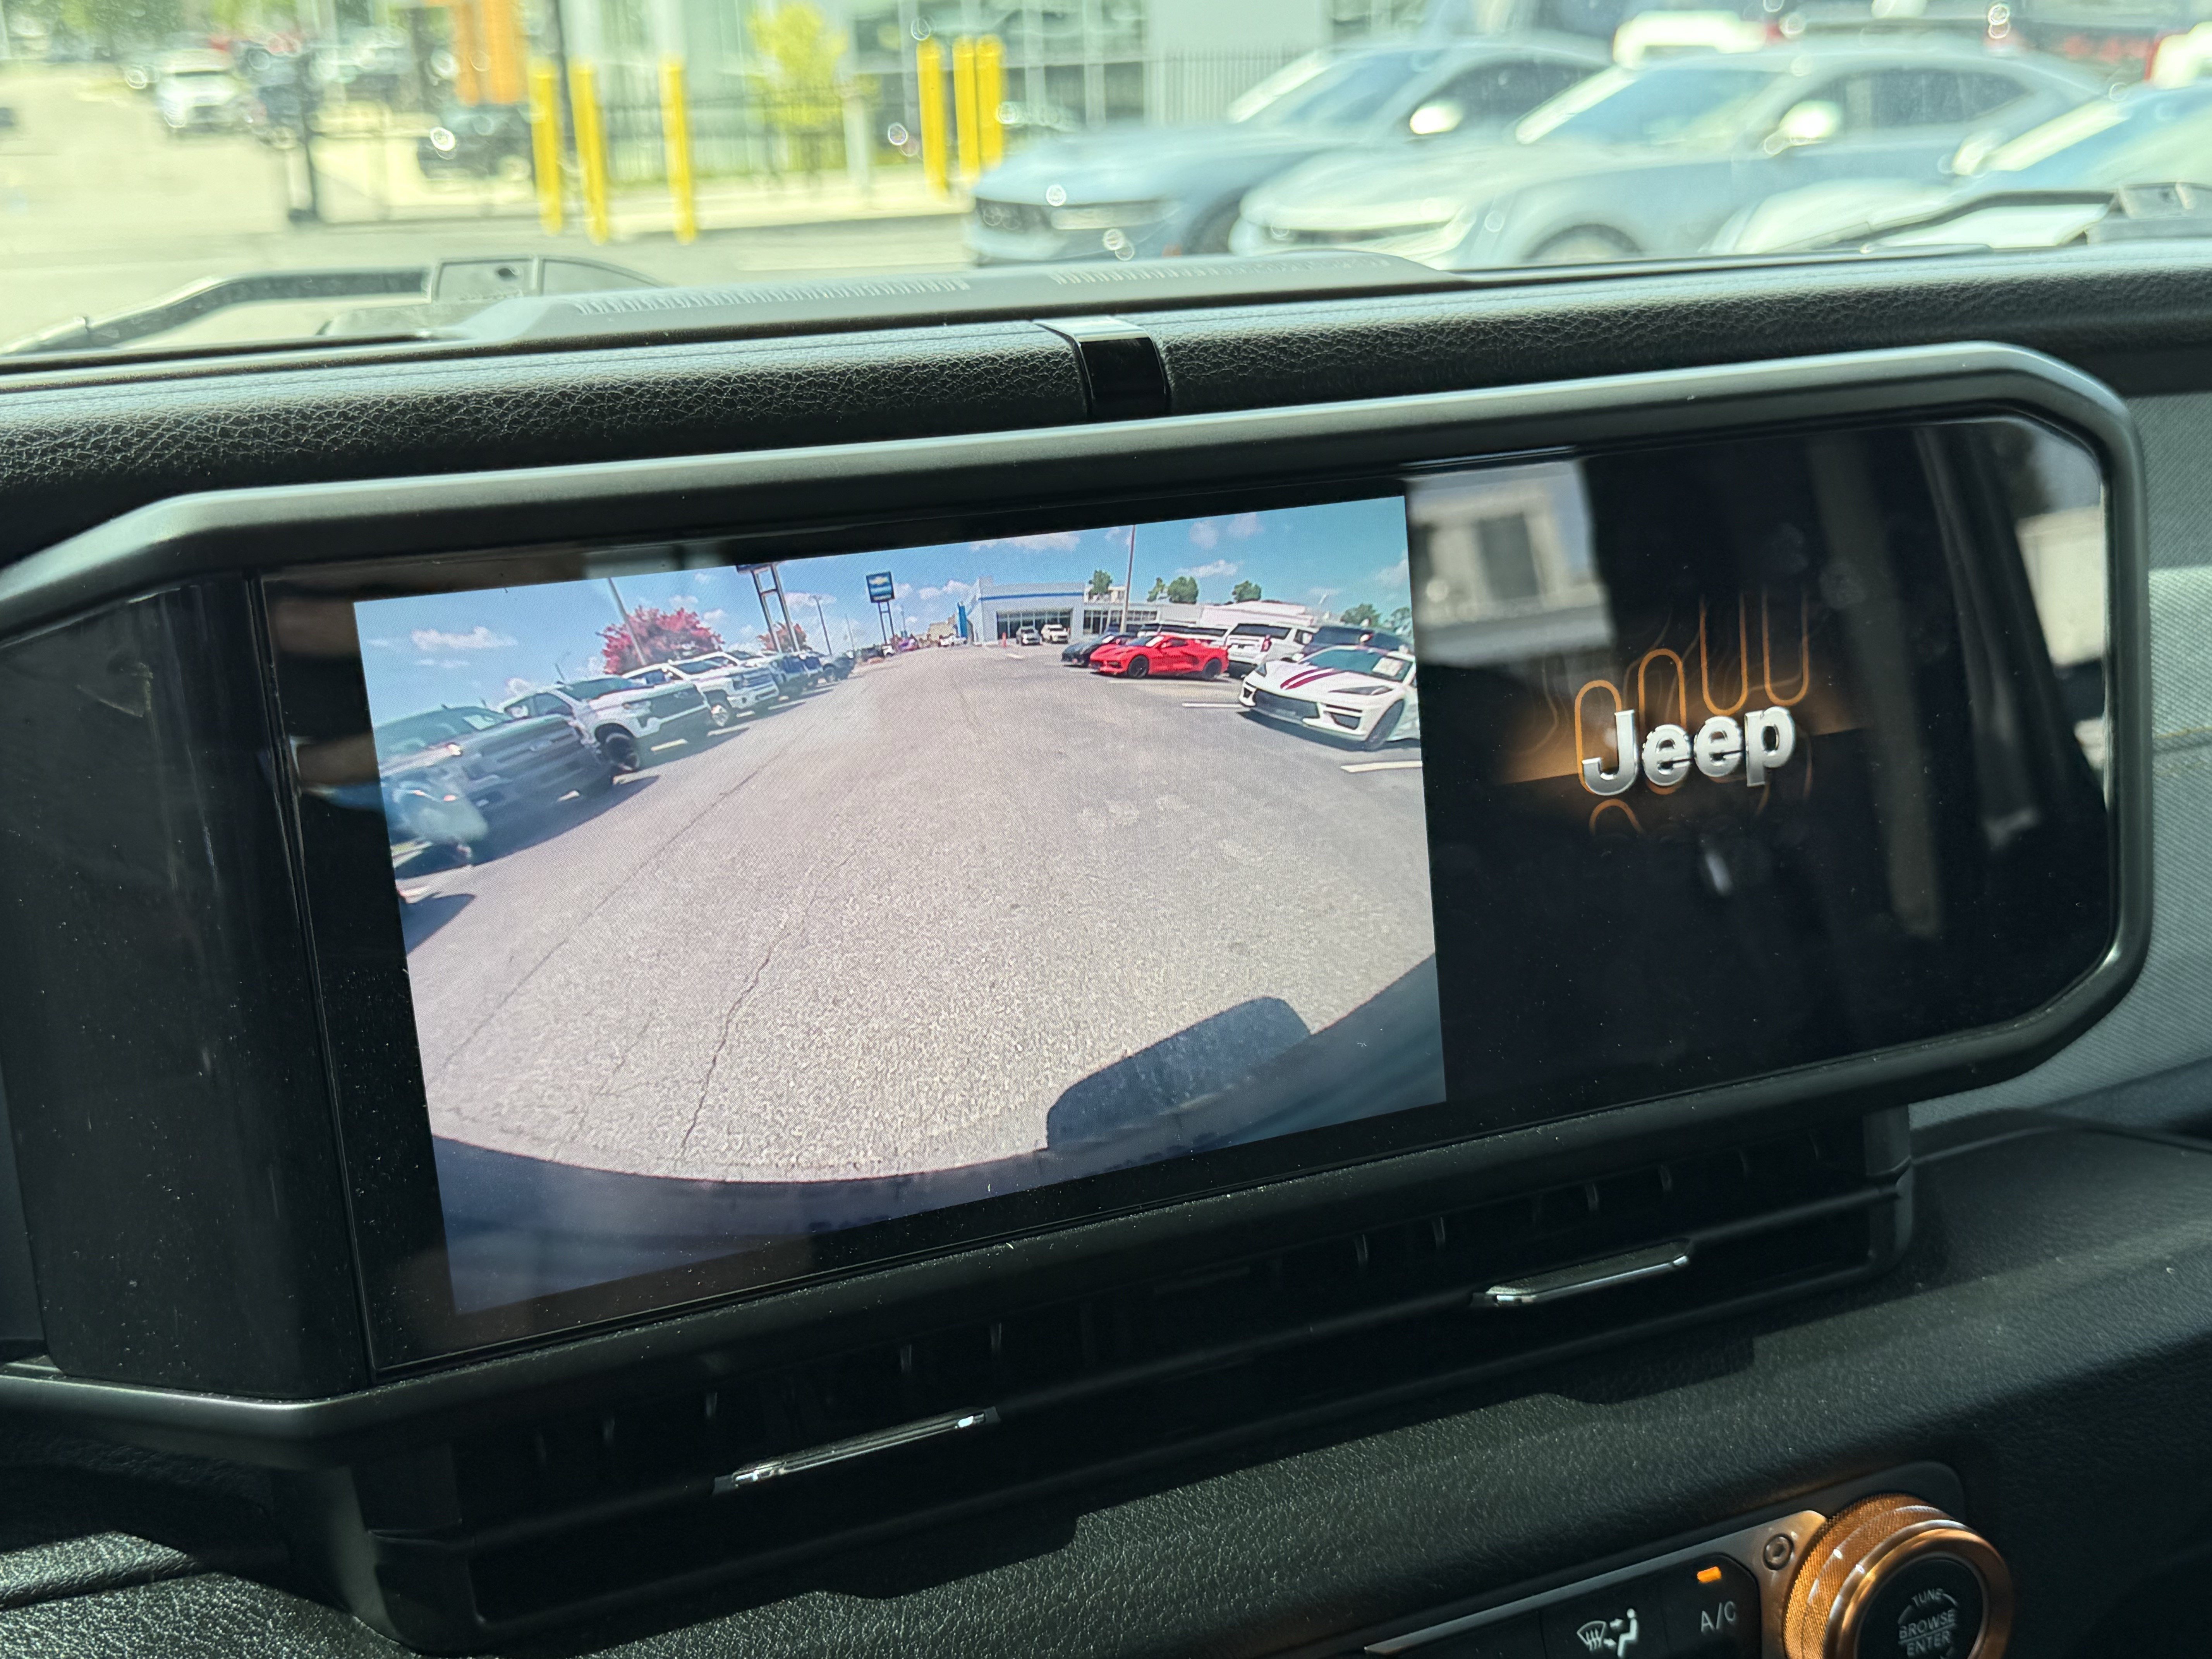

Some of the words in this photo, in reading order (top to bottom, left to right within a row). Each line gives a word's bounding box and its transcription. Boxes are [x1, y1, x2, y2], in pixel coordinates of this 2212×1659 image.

[1582, 706, 1795, 795] Jeep
[1911, 1589, 1943, 1607] TUNE
[1701, 1601, 1736, 1633] A/C
[1899, 1608, 1956, 1639] BROWSE
[1907, 1630, 1951, 1657] ENTER
